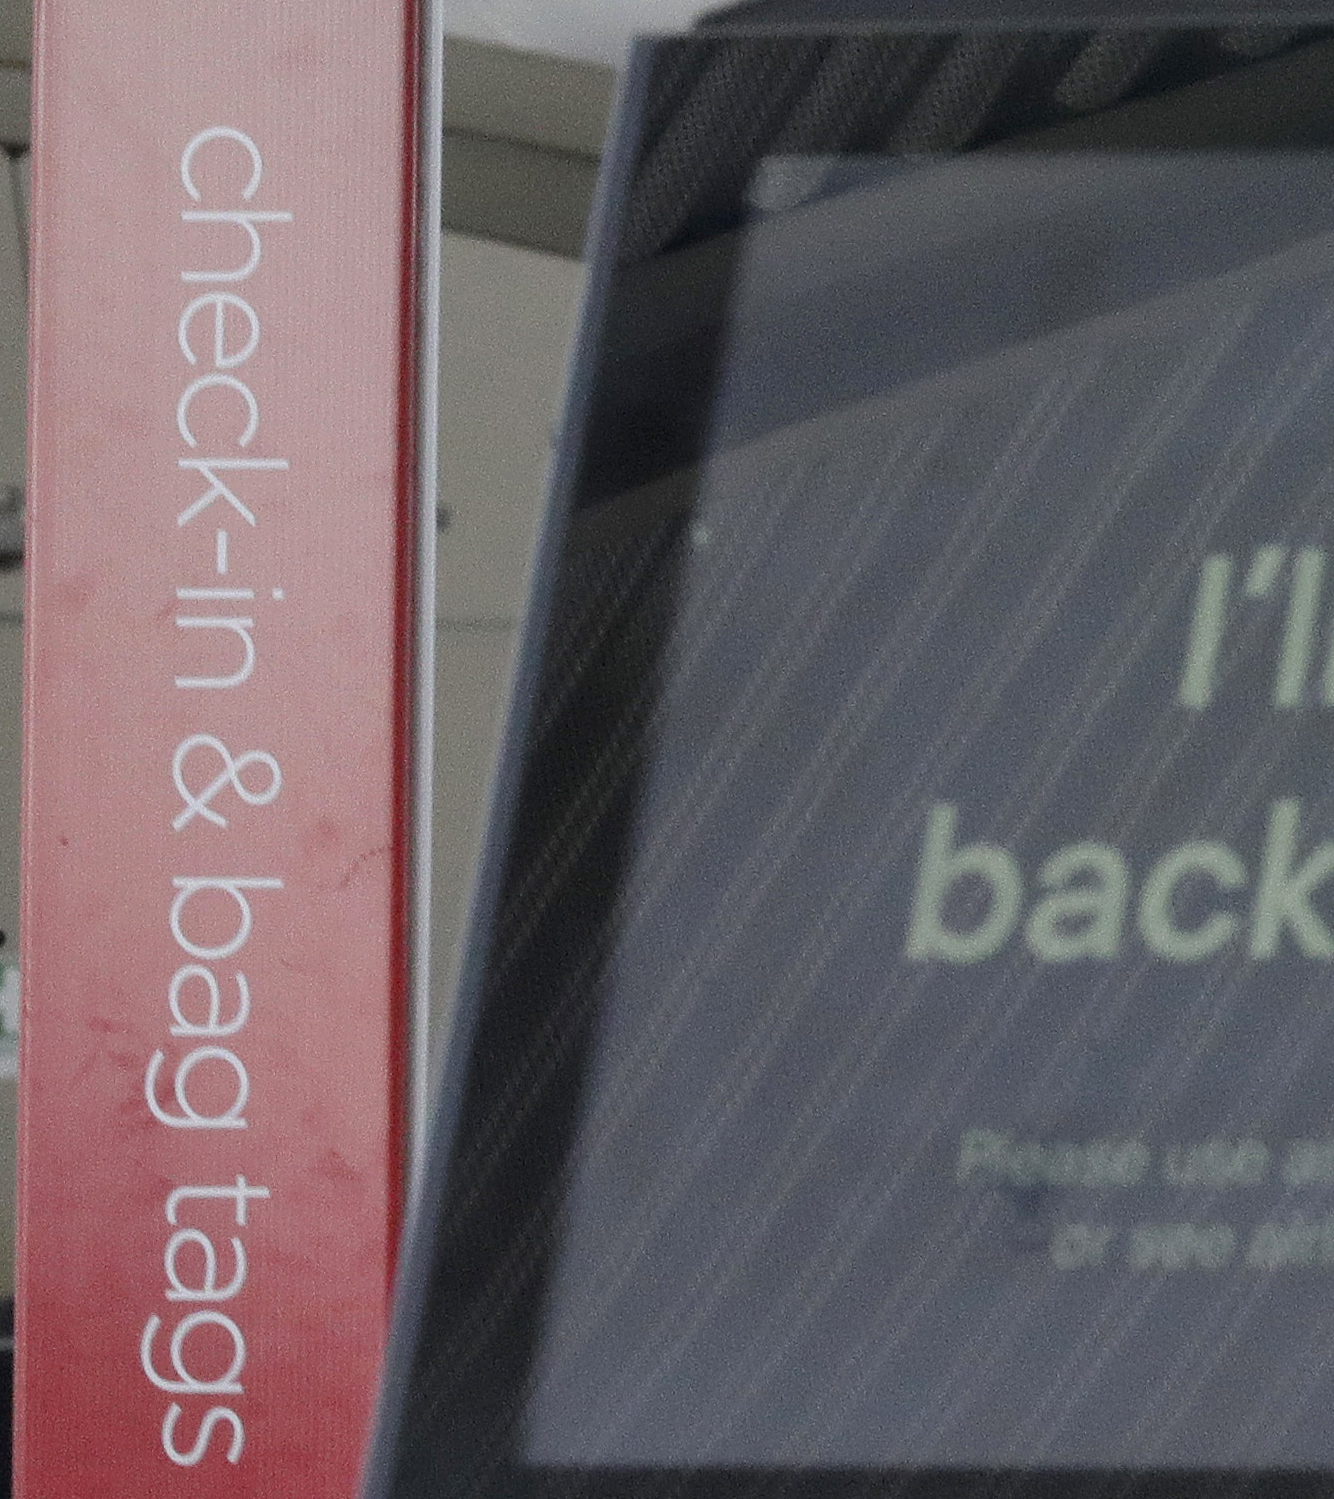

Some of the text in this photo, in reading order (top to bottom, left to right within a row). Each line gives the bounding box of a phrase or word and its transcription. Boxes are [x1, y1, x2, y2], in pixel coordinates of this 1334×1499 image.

[140, 125, 293, 1468] check-in & bag tags
